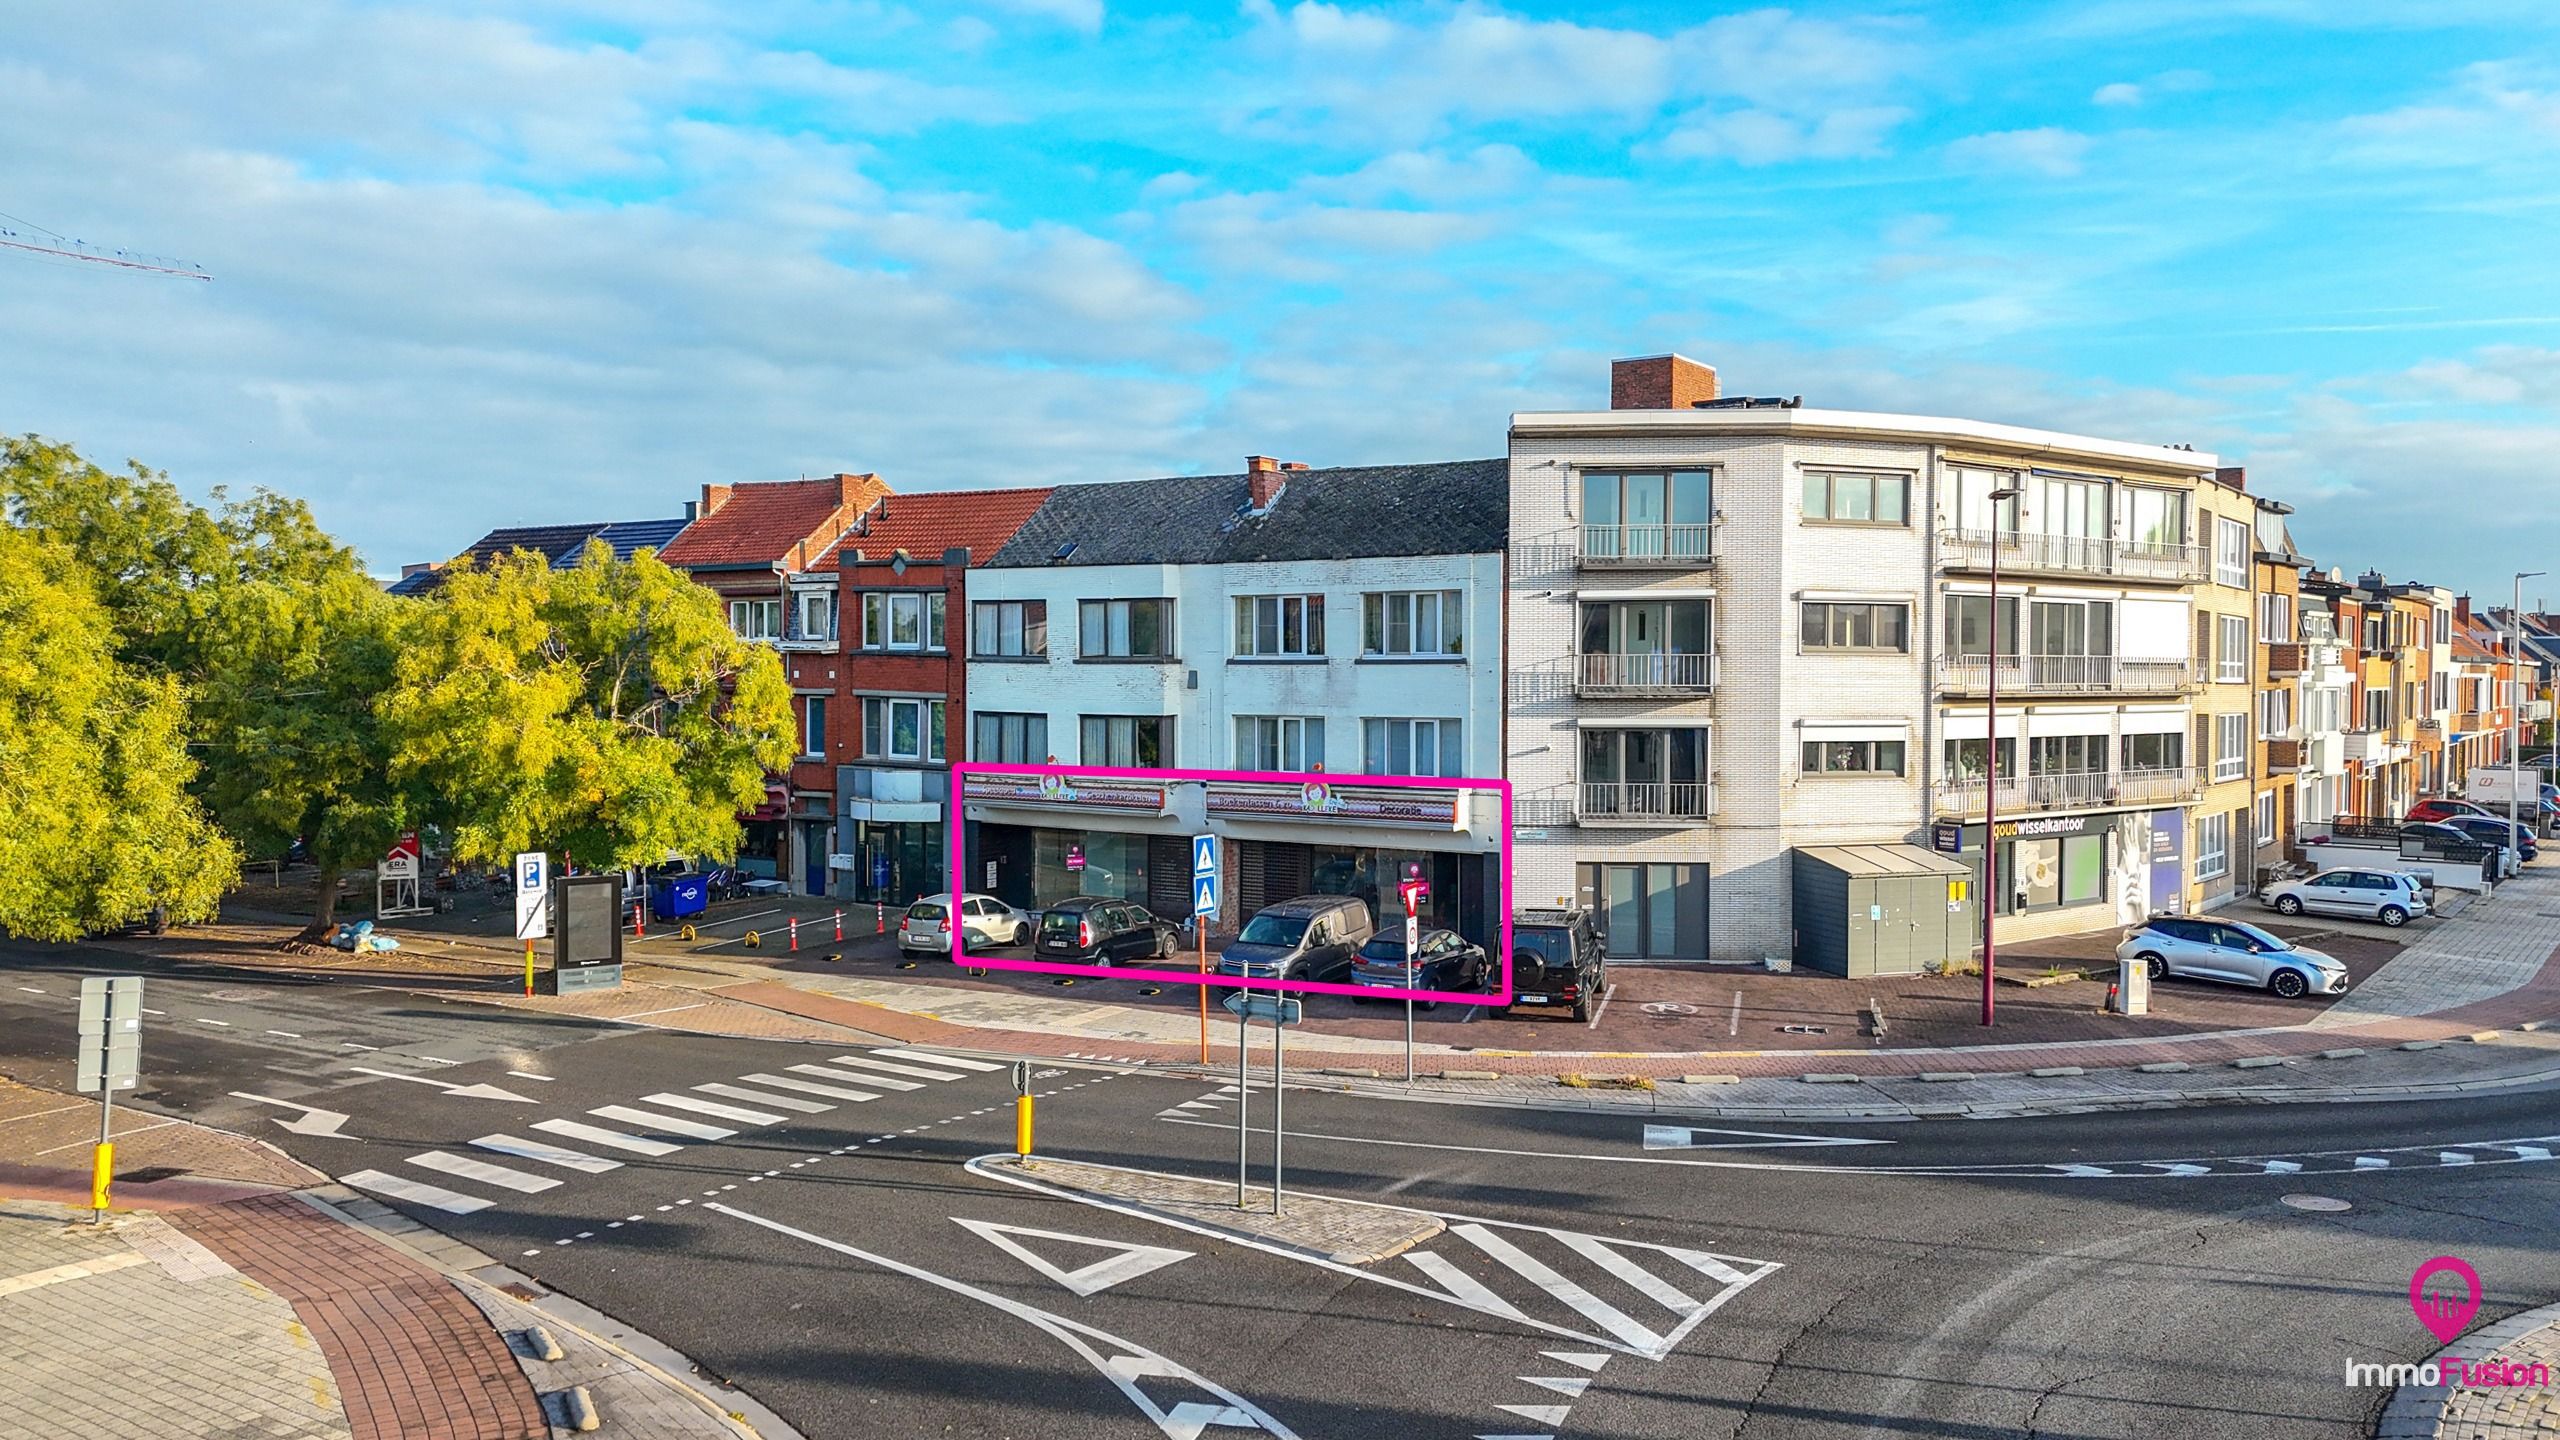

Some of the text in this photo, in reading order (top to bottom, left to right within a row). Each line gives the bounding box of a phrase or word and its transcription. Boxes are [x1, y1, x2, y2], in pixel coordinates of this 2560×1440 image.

[1379, 804, 1422, 815] Decoratie
[1993, 817, 2086, 841] goudwisselkantoor
[388, 860, 408, 868] ERA
[525, 863, 538, 879] P
